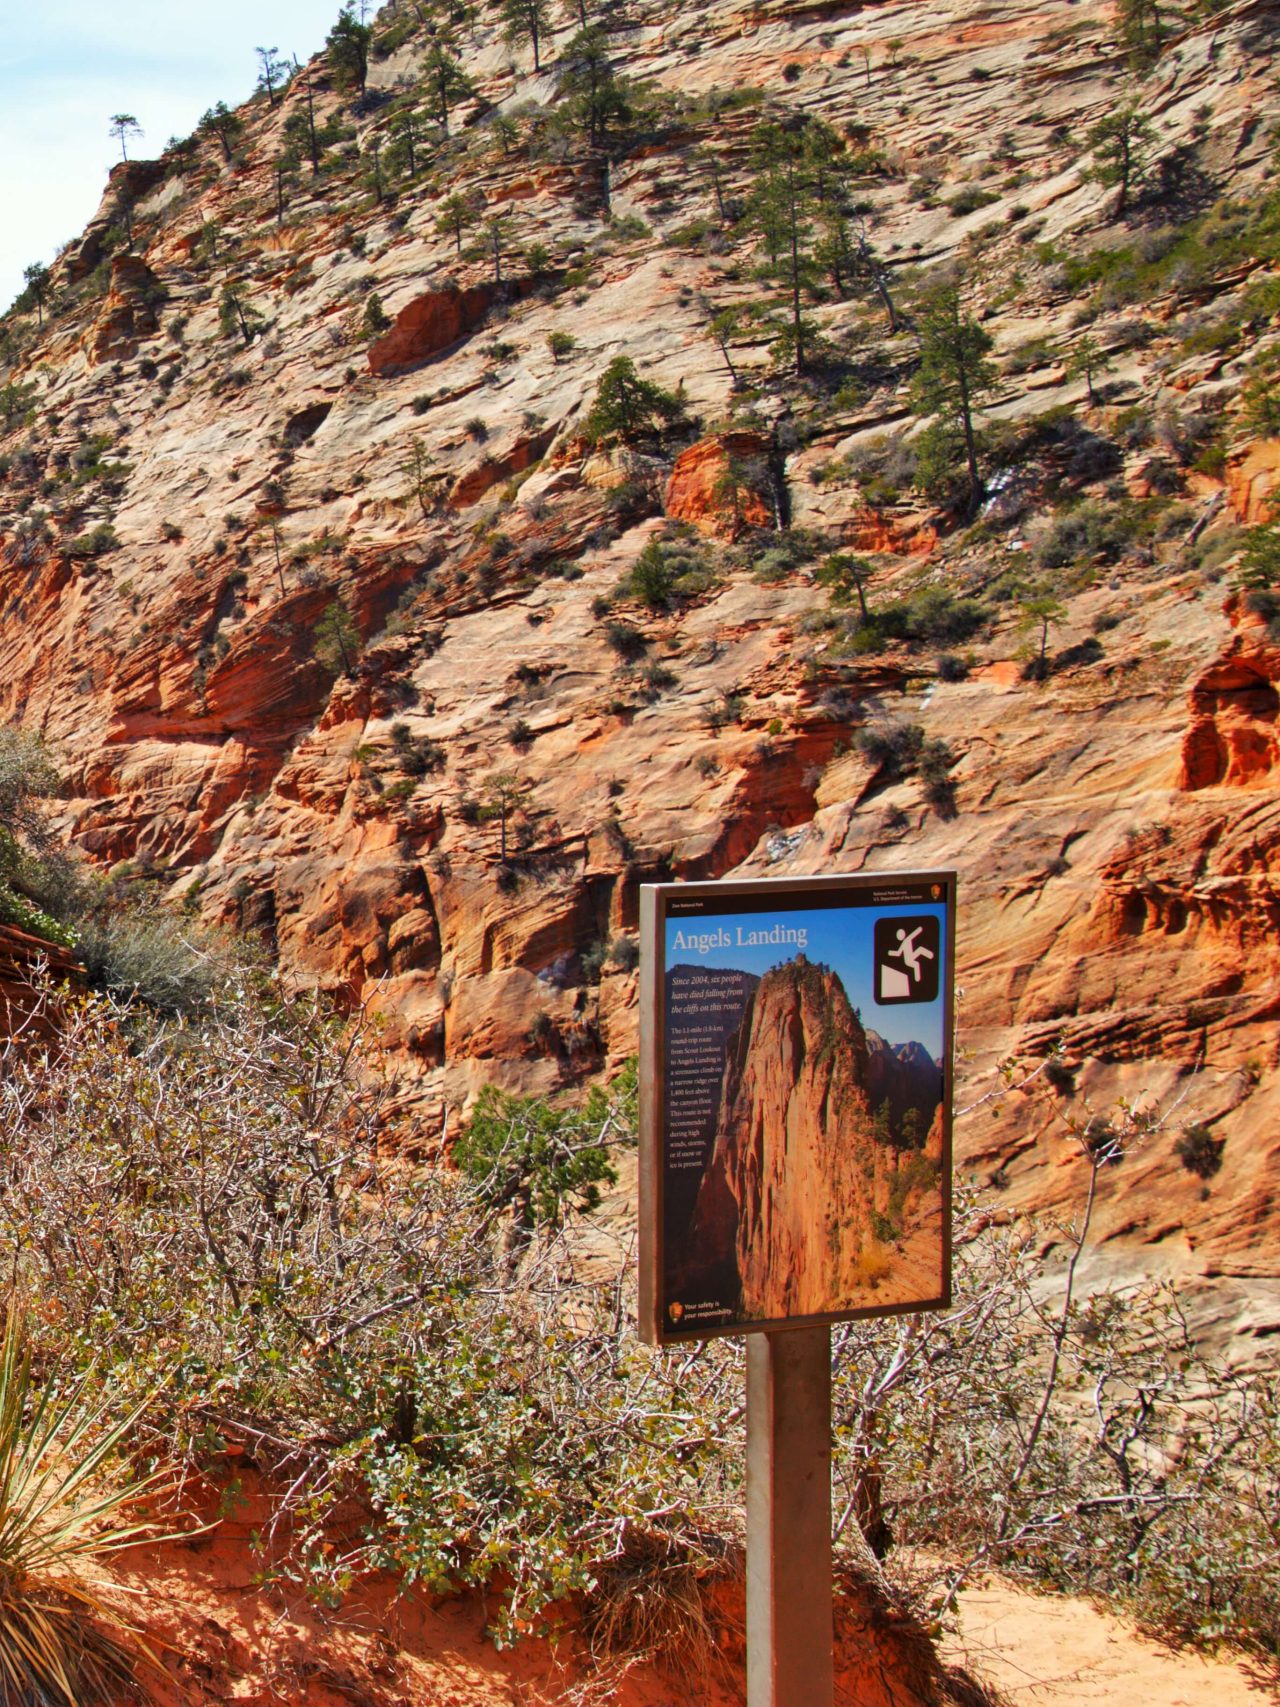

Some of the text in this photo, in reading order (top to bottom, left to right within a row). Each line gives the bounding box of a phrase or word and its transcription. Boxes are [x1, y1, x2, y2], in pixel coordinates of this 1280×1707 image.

[672, 925, 808, 954] Angels Landing
[672, 974, 742, 986] Since 2004, six people
[672, 988, 743, 1000] have died falling from
[672, 1005, 681, 1014] the
[683, 1004, 698, 1014] cliffs
[710, 1003, 721, 1011] this
[723, 1003, 742, 1011] route.
